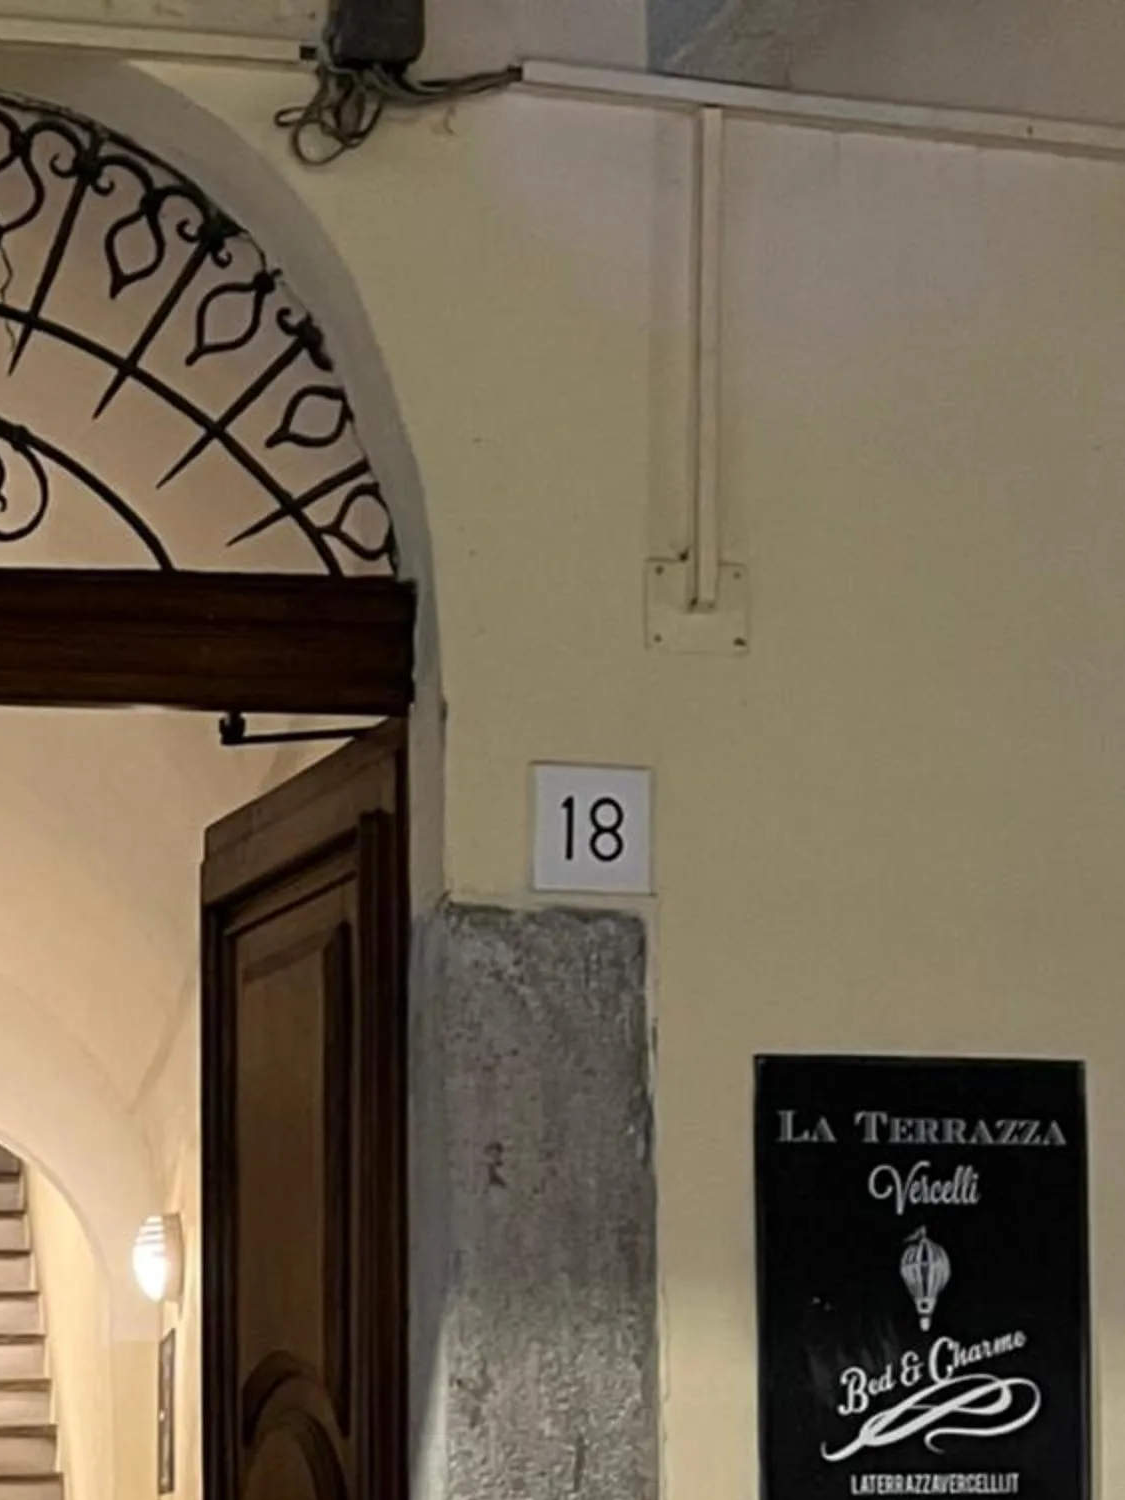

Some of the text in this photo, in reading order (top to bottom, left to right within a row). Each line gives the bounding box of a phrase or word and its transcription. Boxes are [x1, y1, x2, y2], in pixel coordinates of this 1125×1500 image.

[560, 795, 624, 862] 18
[868, 1160, 981, 1216] Vercelli
[837, 1331, 1026, 1415] Bed & Charme
